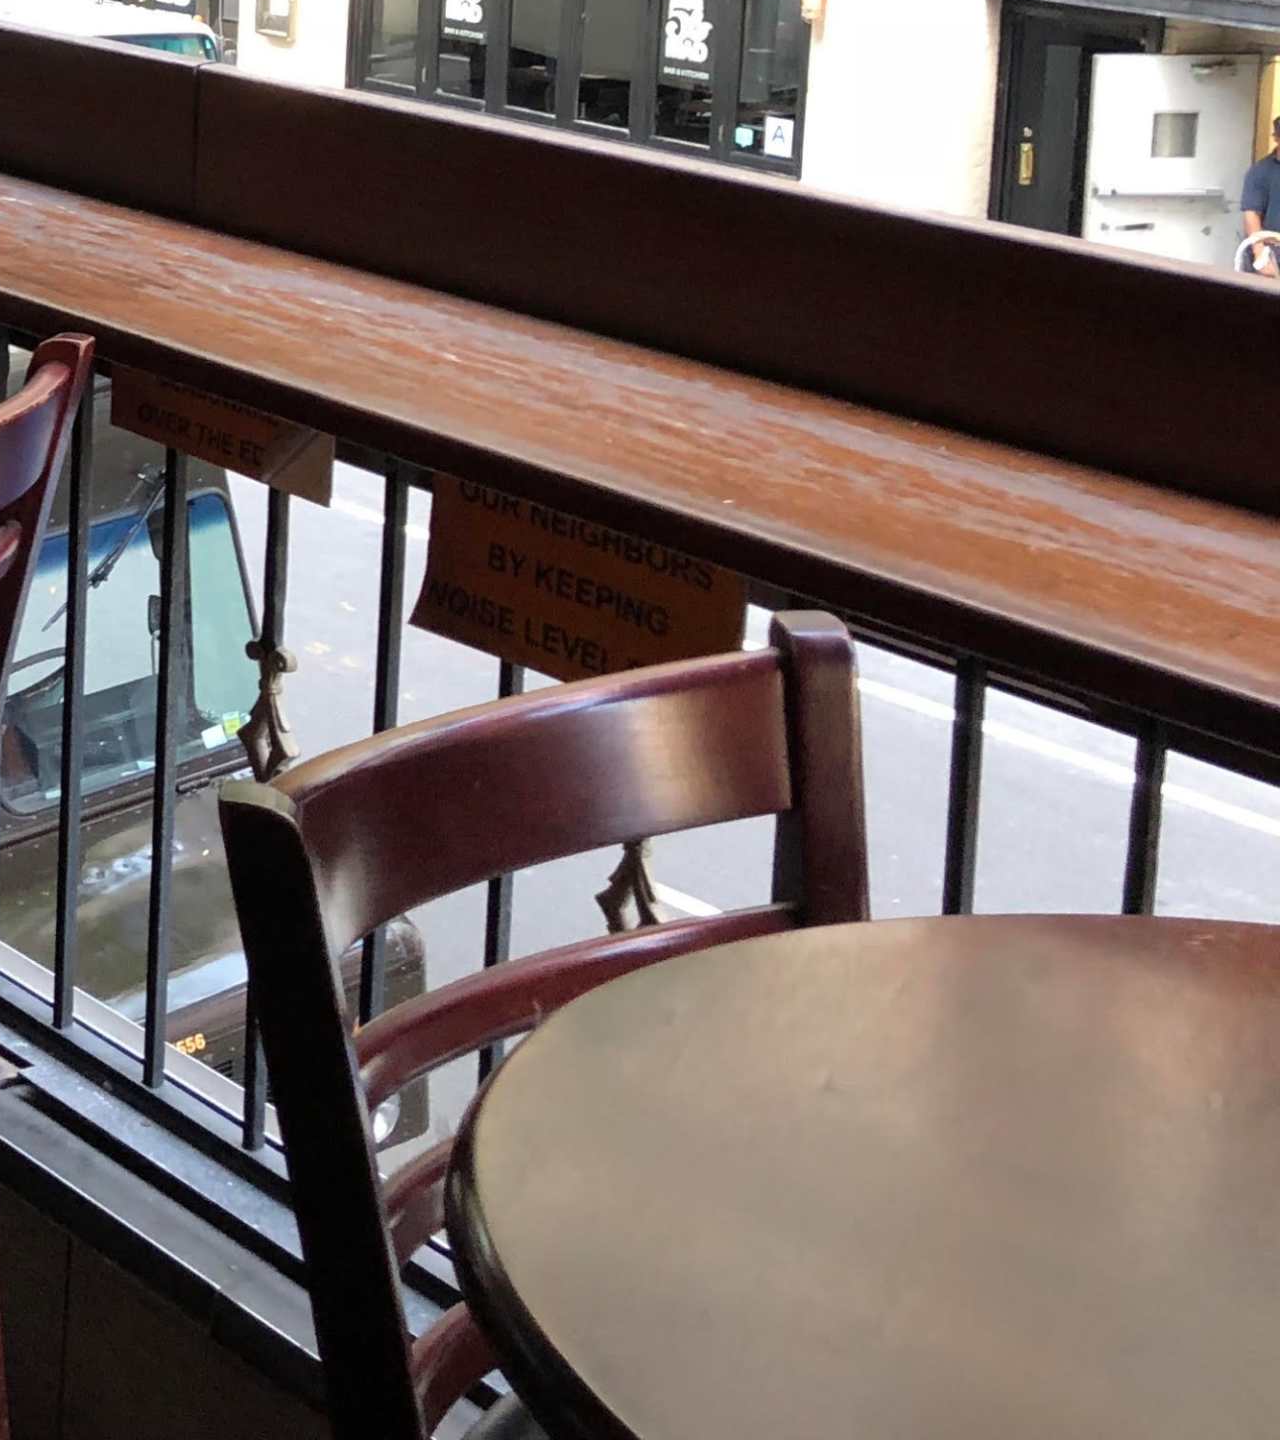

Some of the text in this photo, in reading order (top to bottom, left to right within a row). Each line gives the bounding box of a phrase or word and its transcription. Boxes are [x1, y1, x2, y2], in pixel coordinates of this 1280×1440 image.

[195, 423, 235, 457] THE
[427, 578, 515, 635] NOISE
[489, 543, 671, 636] BY KEEPING
